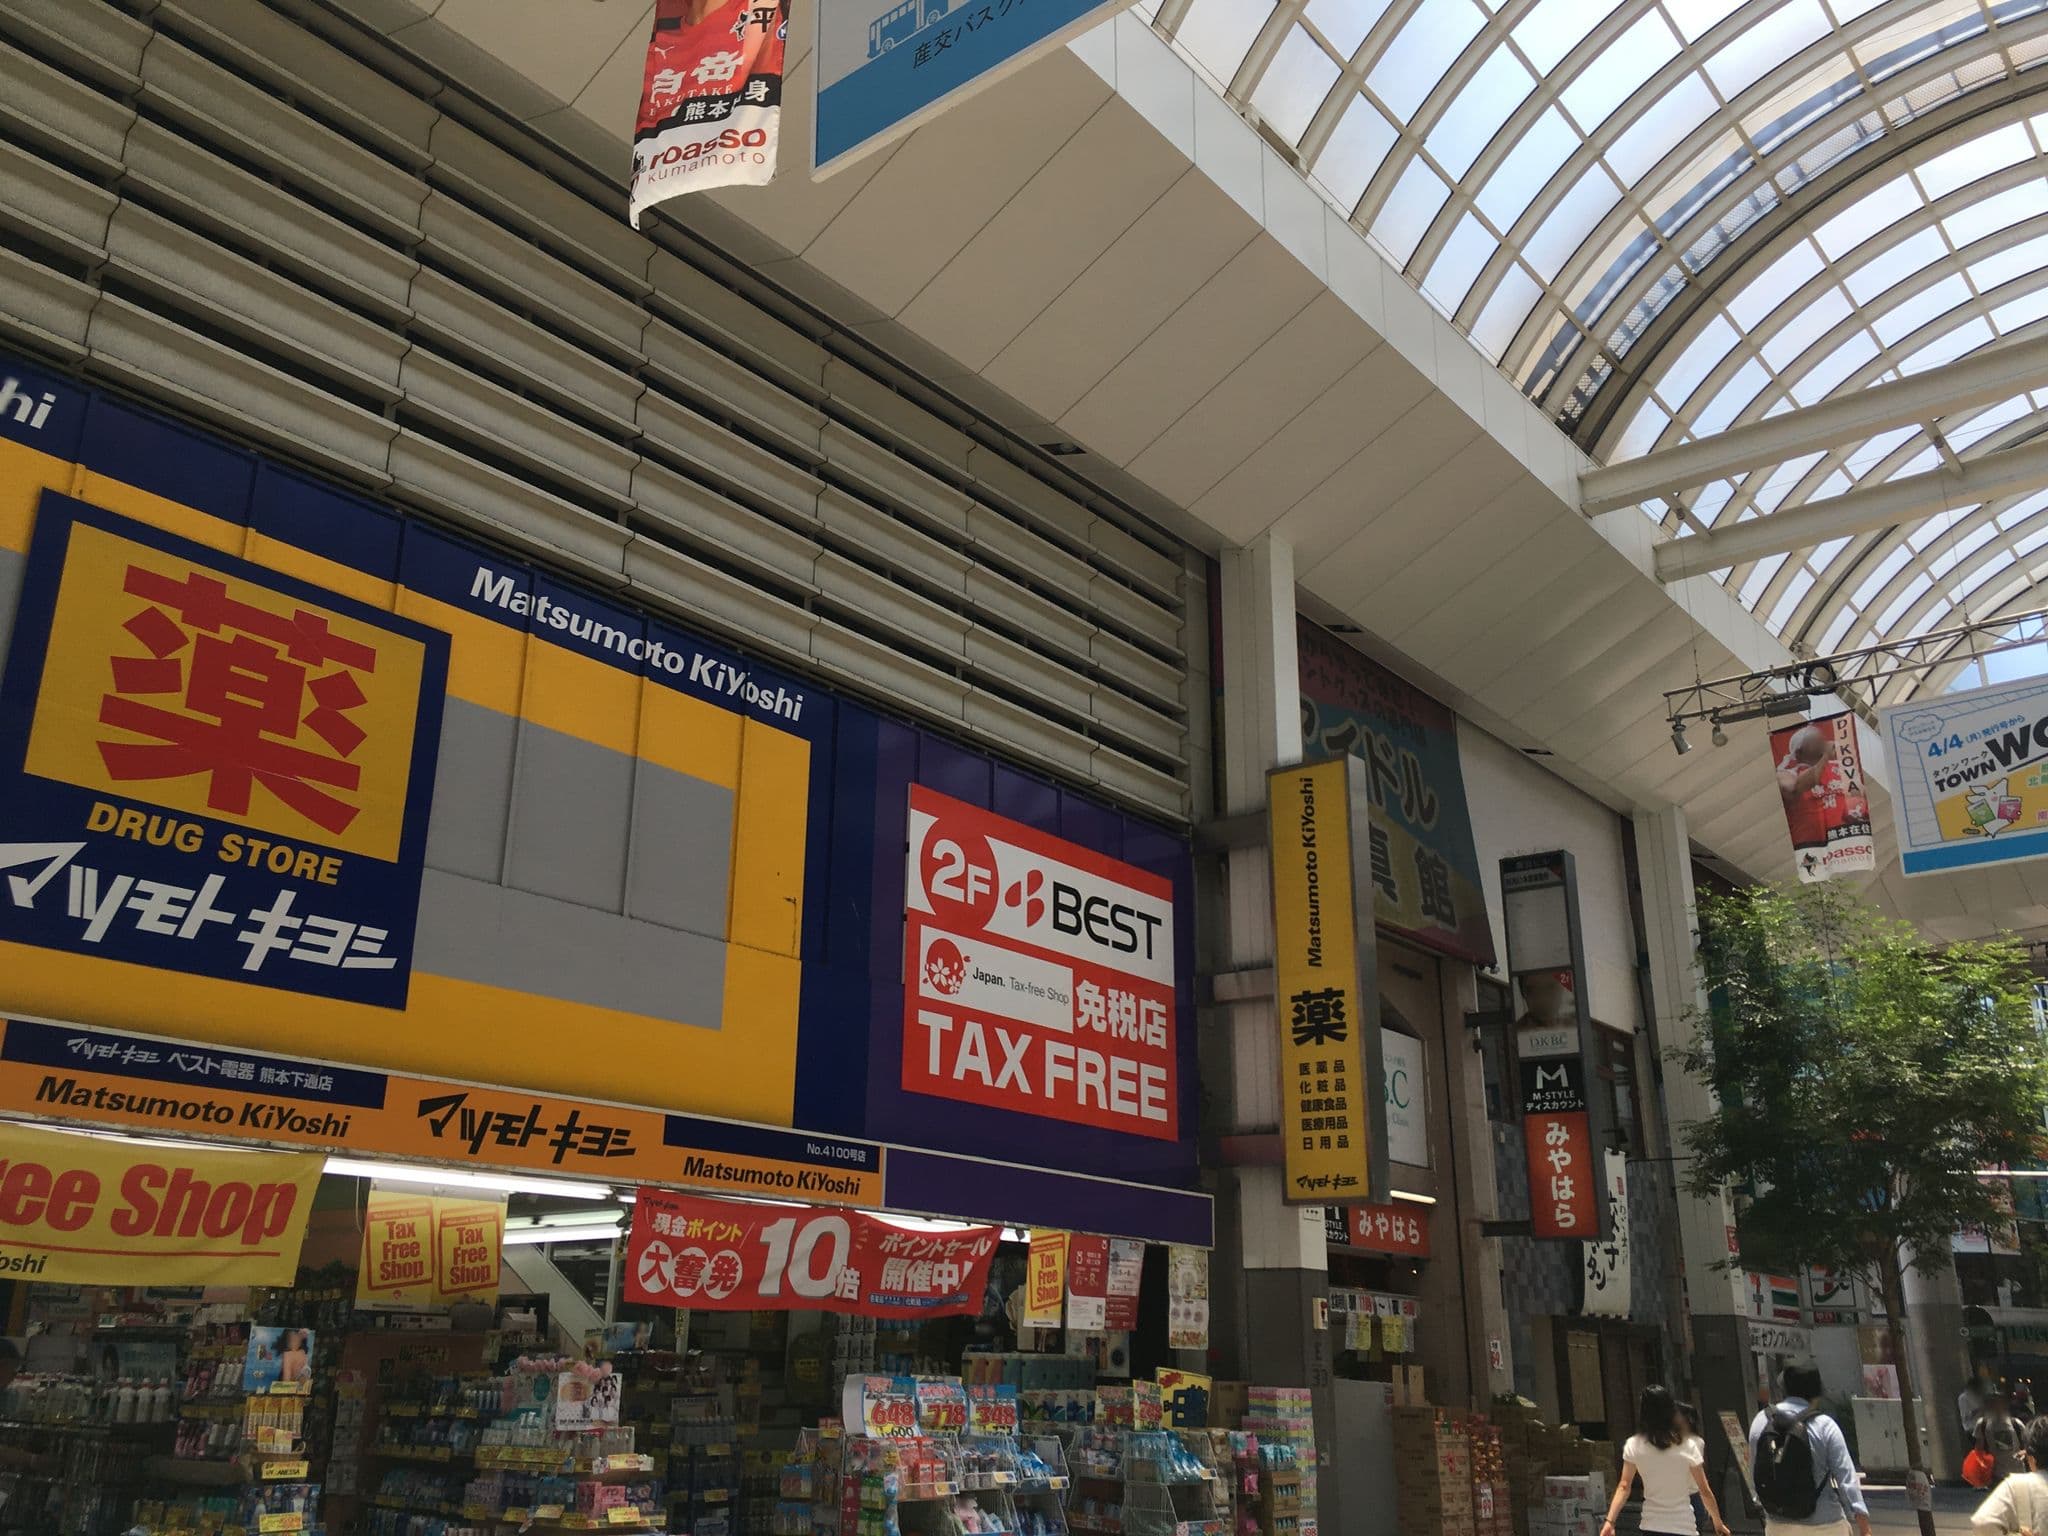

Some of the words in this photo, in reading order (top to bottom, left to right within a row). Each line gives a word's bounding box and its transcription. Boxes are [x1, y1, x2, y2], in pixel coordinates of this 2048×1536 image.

[469, 566, 684, 674] Matsumoto
[689, 653, 803, 722] KiYoshi
[96, 564, 376, 835] 薬
[1927, 733, 1963, 758] 4/4
[1933, 750, 1989, 778] タウンワーク
[1935, 759, 1997, 792] TOWN
[1300, 777, 1317, 848] KiYoshi
[86, 801, 205, 853] DRUG
[217, 833, 343, 886] STORE
[931, 838, 992, 905] 2F
[1053, 880, 1162, 960] BEST
[1303, 850, 1322, 968] Matsumoto
[973, 967, 1006, 987] Japan.
[1009, 976, 1045, 998] Tax-free
[1047, 987, 1070, 1005] Shop
[1076, 979, 1167, 1049] 免税店
[1291, 987, 1347, 1046] 薬
[168, 1051, 255, 1080] ベスト電器
[260, 1066, 334, 1092] 熊本下通店
[918, 1009, 1032, 1095] TAX
[1045, 1039, 1168, 1123] FREE
[1299, 1059, 1346, 1076] 医薬品
[1299, 1078, 1346, 1094] 化粧品
[1532, 1090, 1575, 1101] M-STYLE
[35, 1075, 234, 1125] Matsumoto
[239, 1102, 352, 1138] KiYoshi
[1301, 1097, 1347, 1113] 健康食品
[1525, 1099, 1585, 1112] ディスカウント
[418, 1092, 637, 1164] マツモトキヨシ
[1302, 1115, 1348, 1132] 医療用品
[806, 1141, 867, 1164] No.4100号店
[1303, 1135, 1349, 1150] 日用品
[683, 1157, 794, 1189] Matsumoto
[797, 1170, 861, 1197] KiYoshi
[1544, 1122, 1577, 1229] みやはら
[0, 1160, 101, 1231] ee
[110, 1163, 297, 1245] Shop
[386, 1221, 416, 1239] Tax
[456, 1227, 483, 1245] Tax
[652, 1212, 743, 1244] 現金ポイント
[879, 1231, 993, 1258] ポイントセール
[1358, 1209, 1420, 1246] みやはら
[383, 1241, 420, 1260] Free
[453, 1246, 488, 1265] Free
[1039, 1252, 1056, 1268] Tax
[380, 1260, 424, 1281] Shop
[450, 1263, 491, 1285] Shop
[1038, 1269, 1058, 1285] Free
[1037, 1286, 1059, 1303] Shop
[872, 1400, 916, 1427] 648
